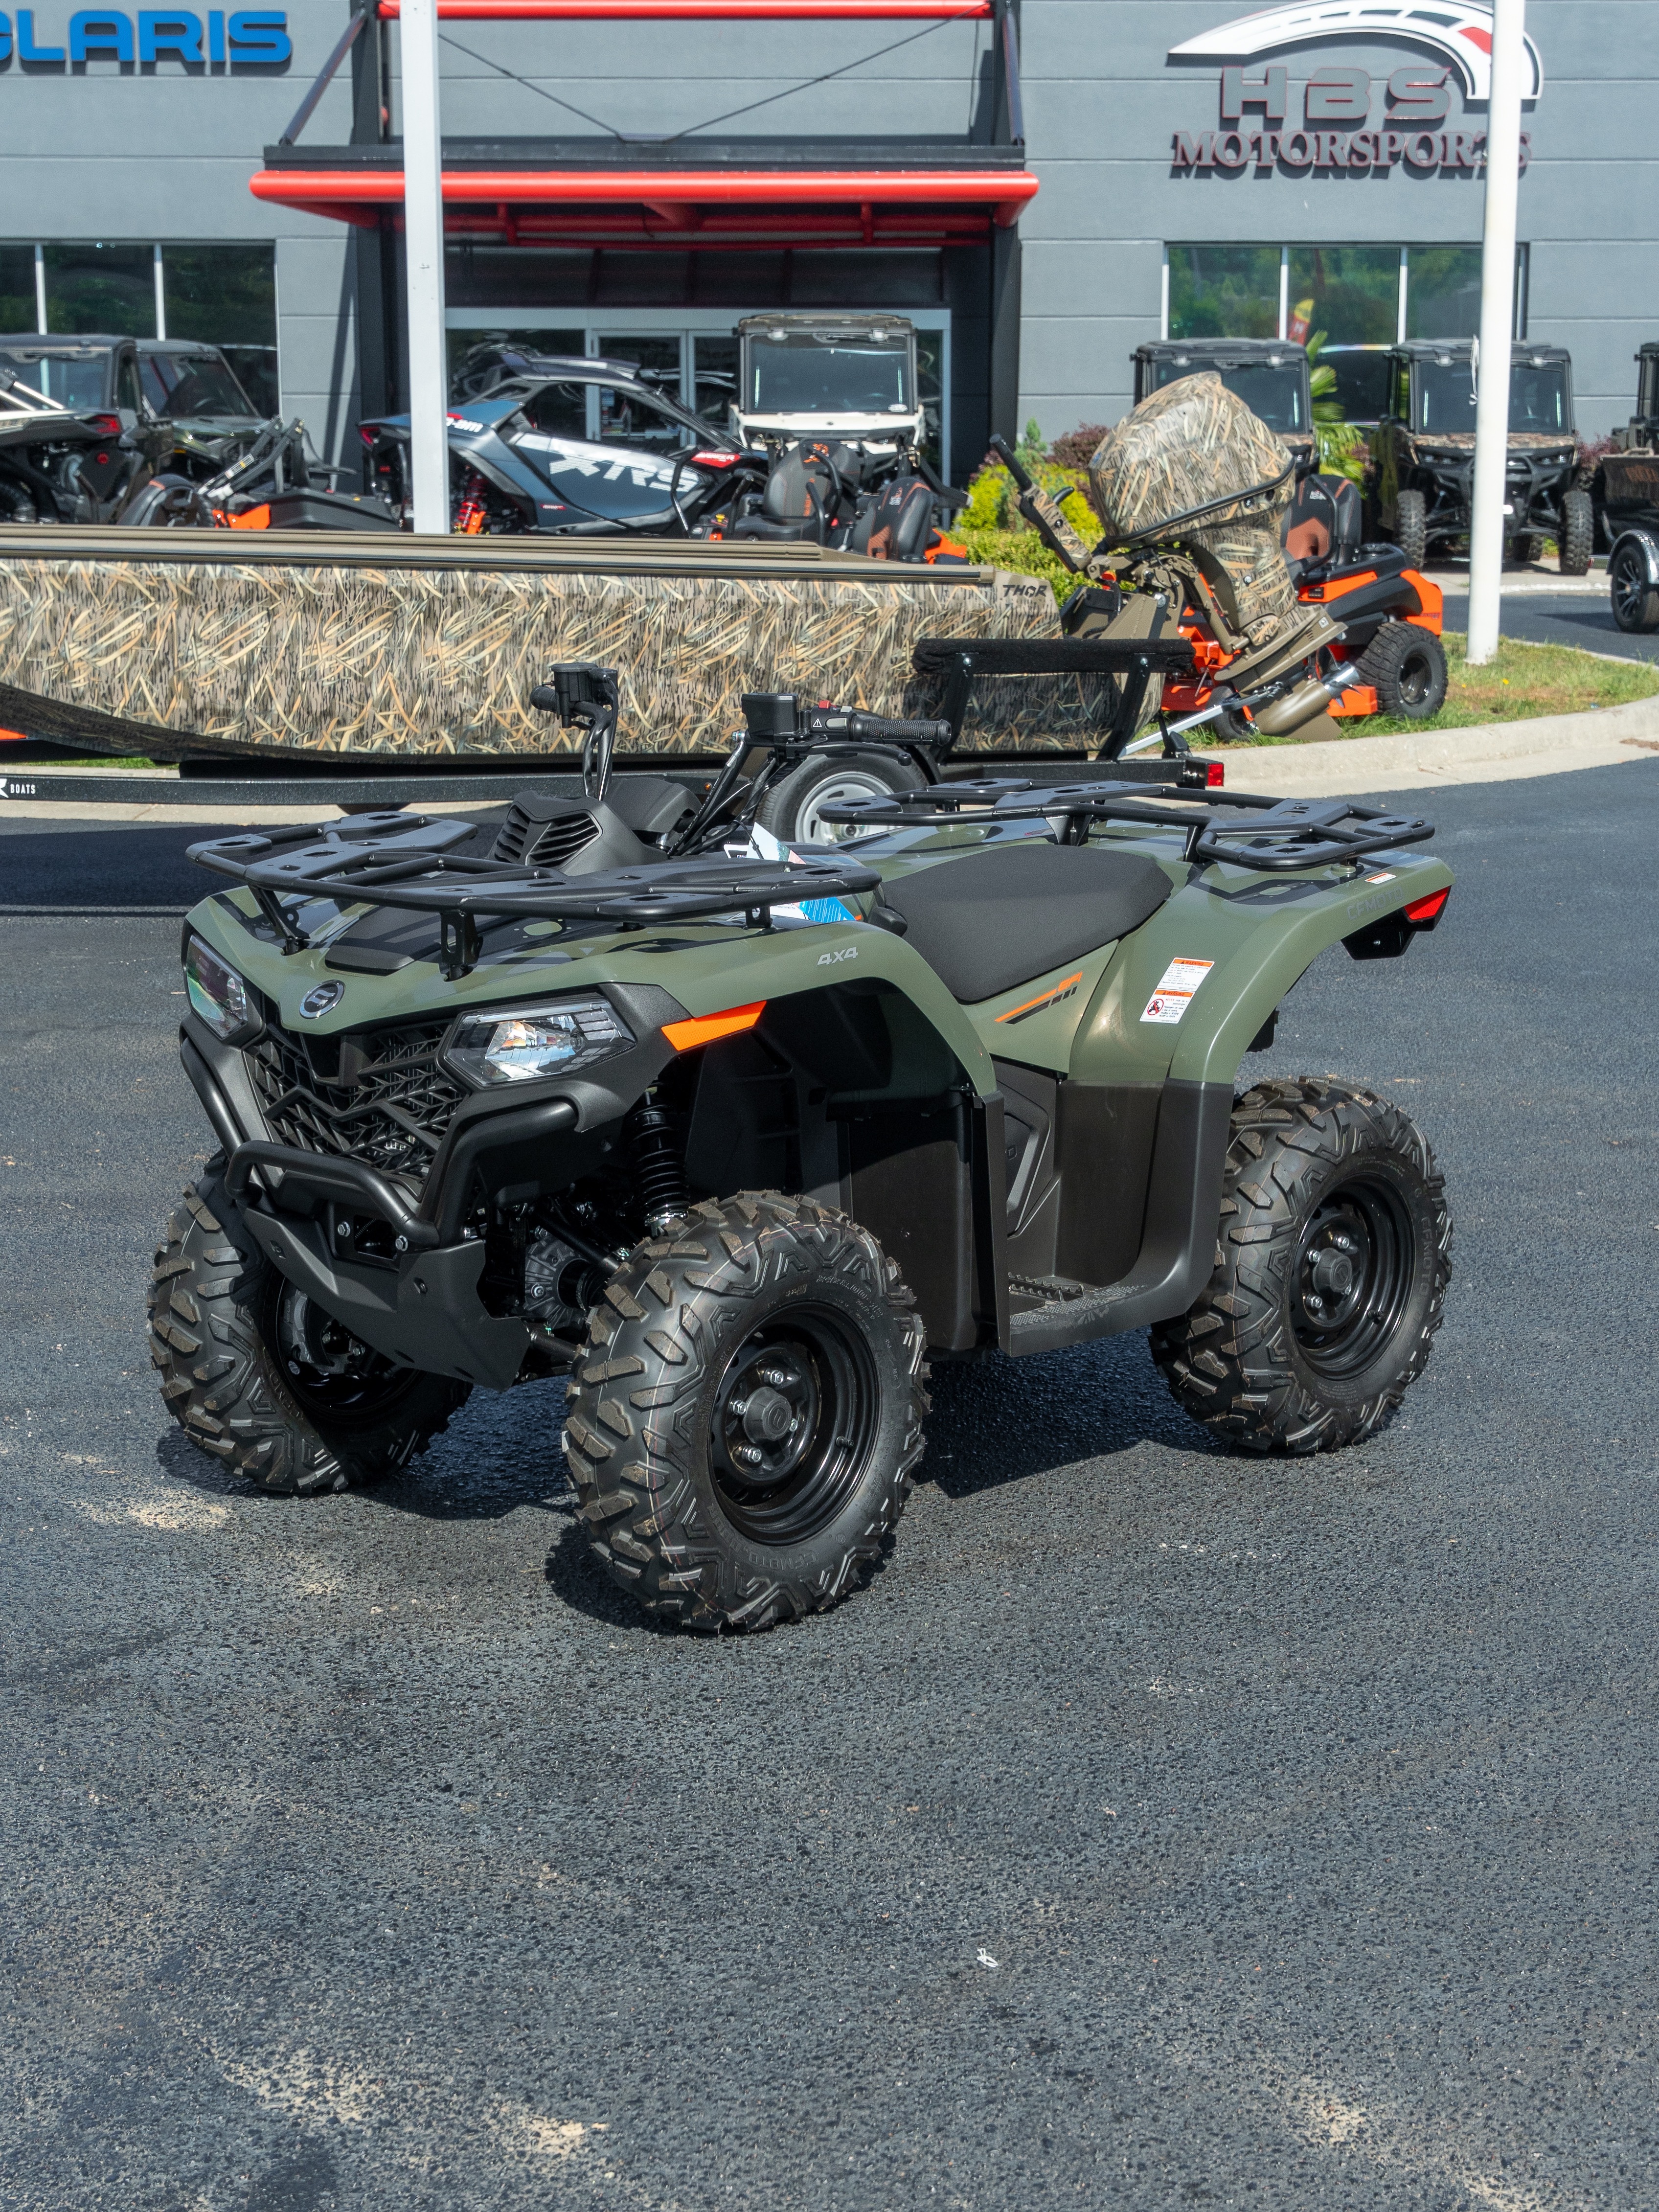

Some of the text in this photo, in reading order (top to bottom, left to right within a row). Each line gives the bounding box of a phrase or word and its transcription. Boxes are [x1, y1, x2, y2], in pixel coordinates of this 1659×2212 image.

[1222, 67, 1452, 119] HBS
[1002, 585, 1047, 597] THOR
[10, 784, 36, 794] BOATS
[1347, 886, 1404, 920] CFMOTO
[1057, 971, 1083, 992] EFI
